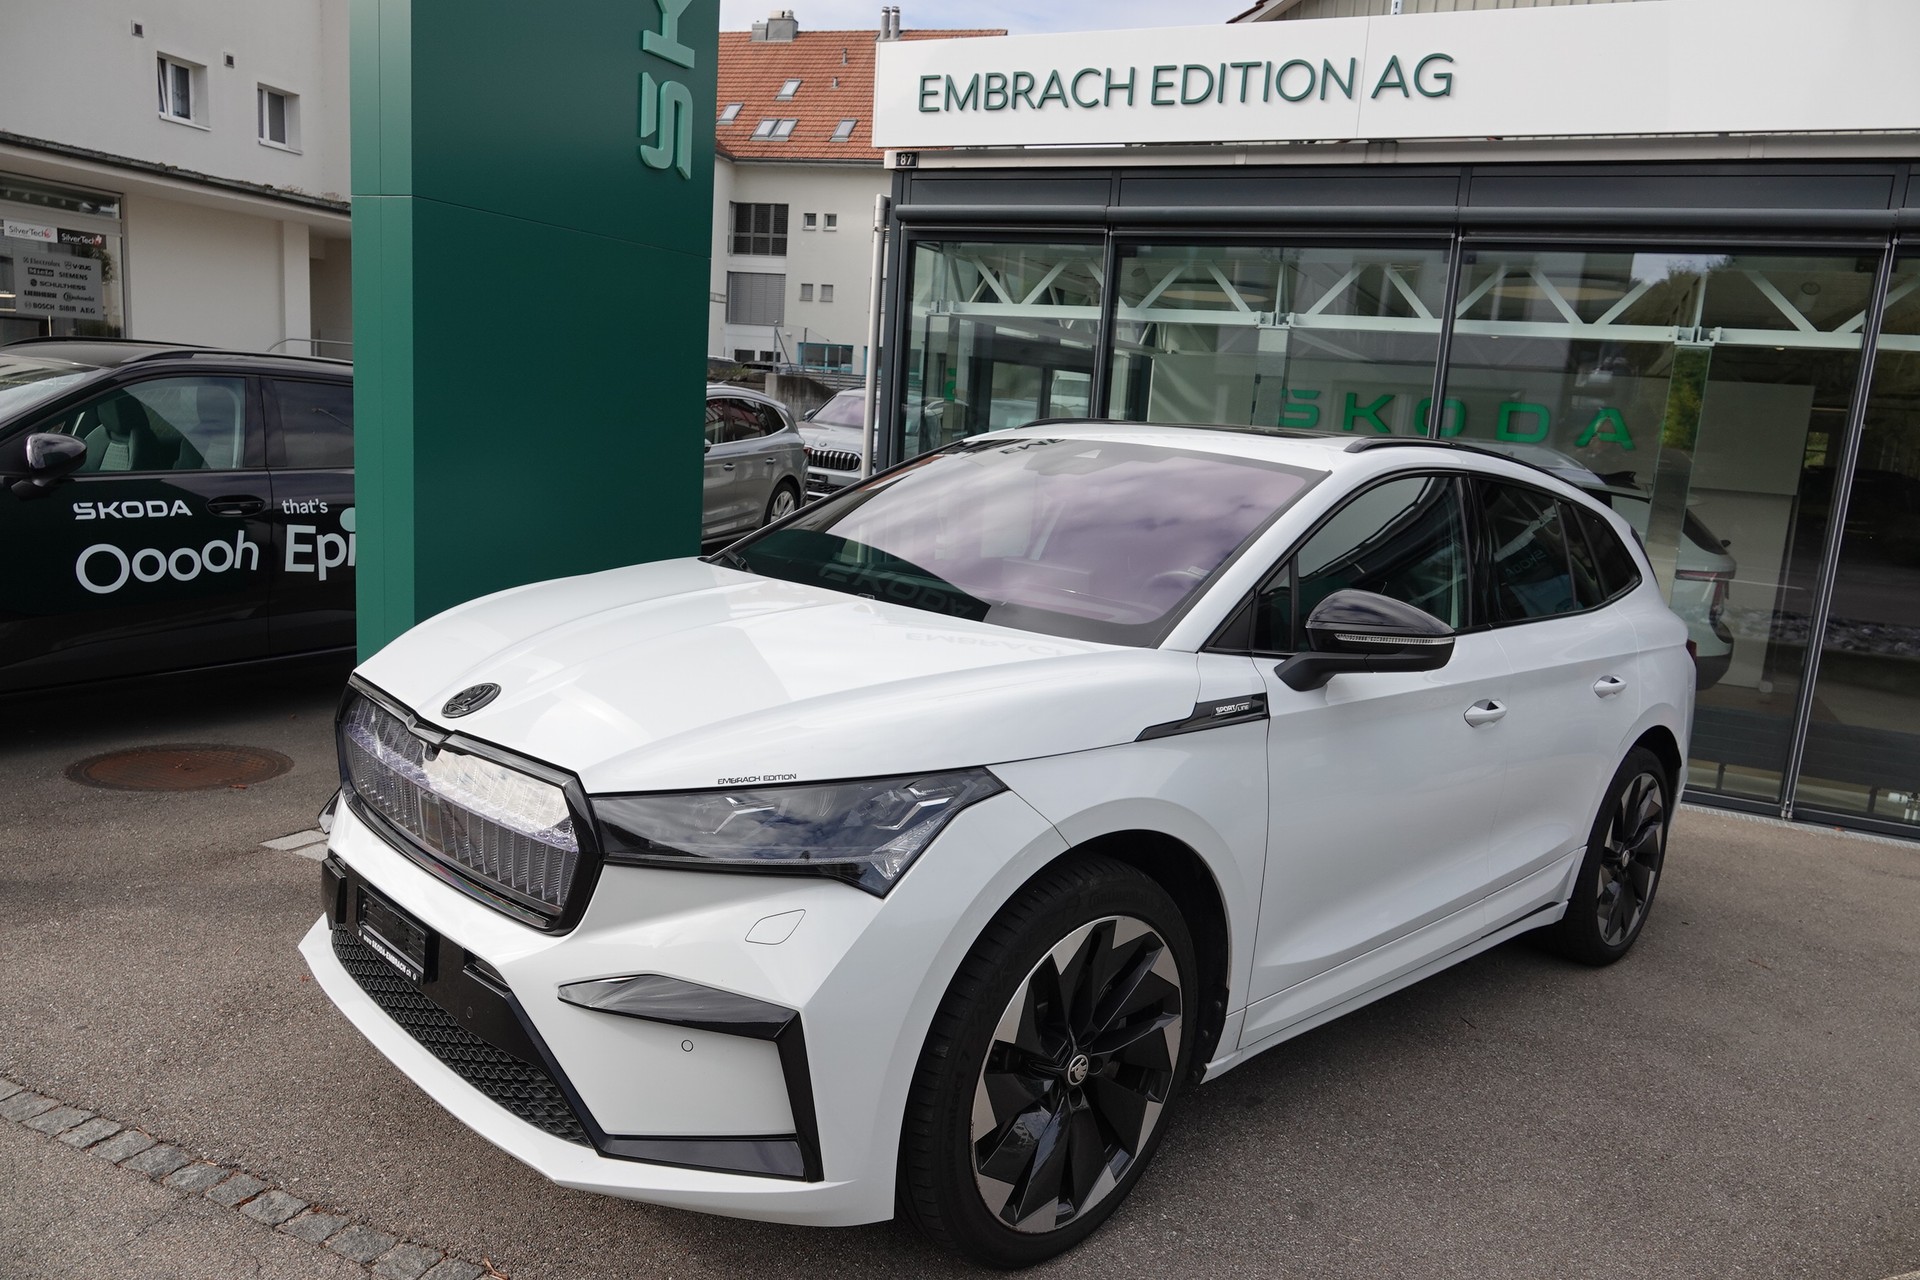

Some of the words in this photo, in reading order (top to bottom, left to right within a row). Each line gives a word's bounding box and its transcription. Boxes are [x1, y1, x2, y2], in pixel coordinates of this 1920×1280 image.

[919, 67, 1136, 112] EMBRACH
[1151, 57, 1356, 106] EDITION
[1371, 53, 1454, 98] AG
[900, 153, 913, 166] 87
[59, 272, 88, 280] SIEMENS
[40, 281, 86, 290] SCHULTHESS
[33, 302, 55, 310] BOSCH
[282, 498, 328, 515] that's
[76, 529, 259, 594] Ooooh
[717, 775, 760, 785] EMBRACH
[763, 773, 797, 782] EDITION
